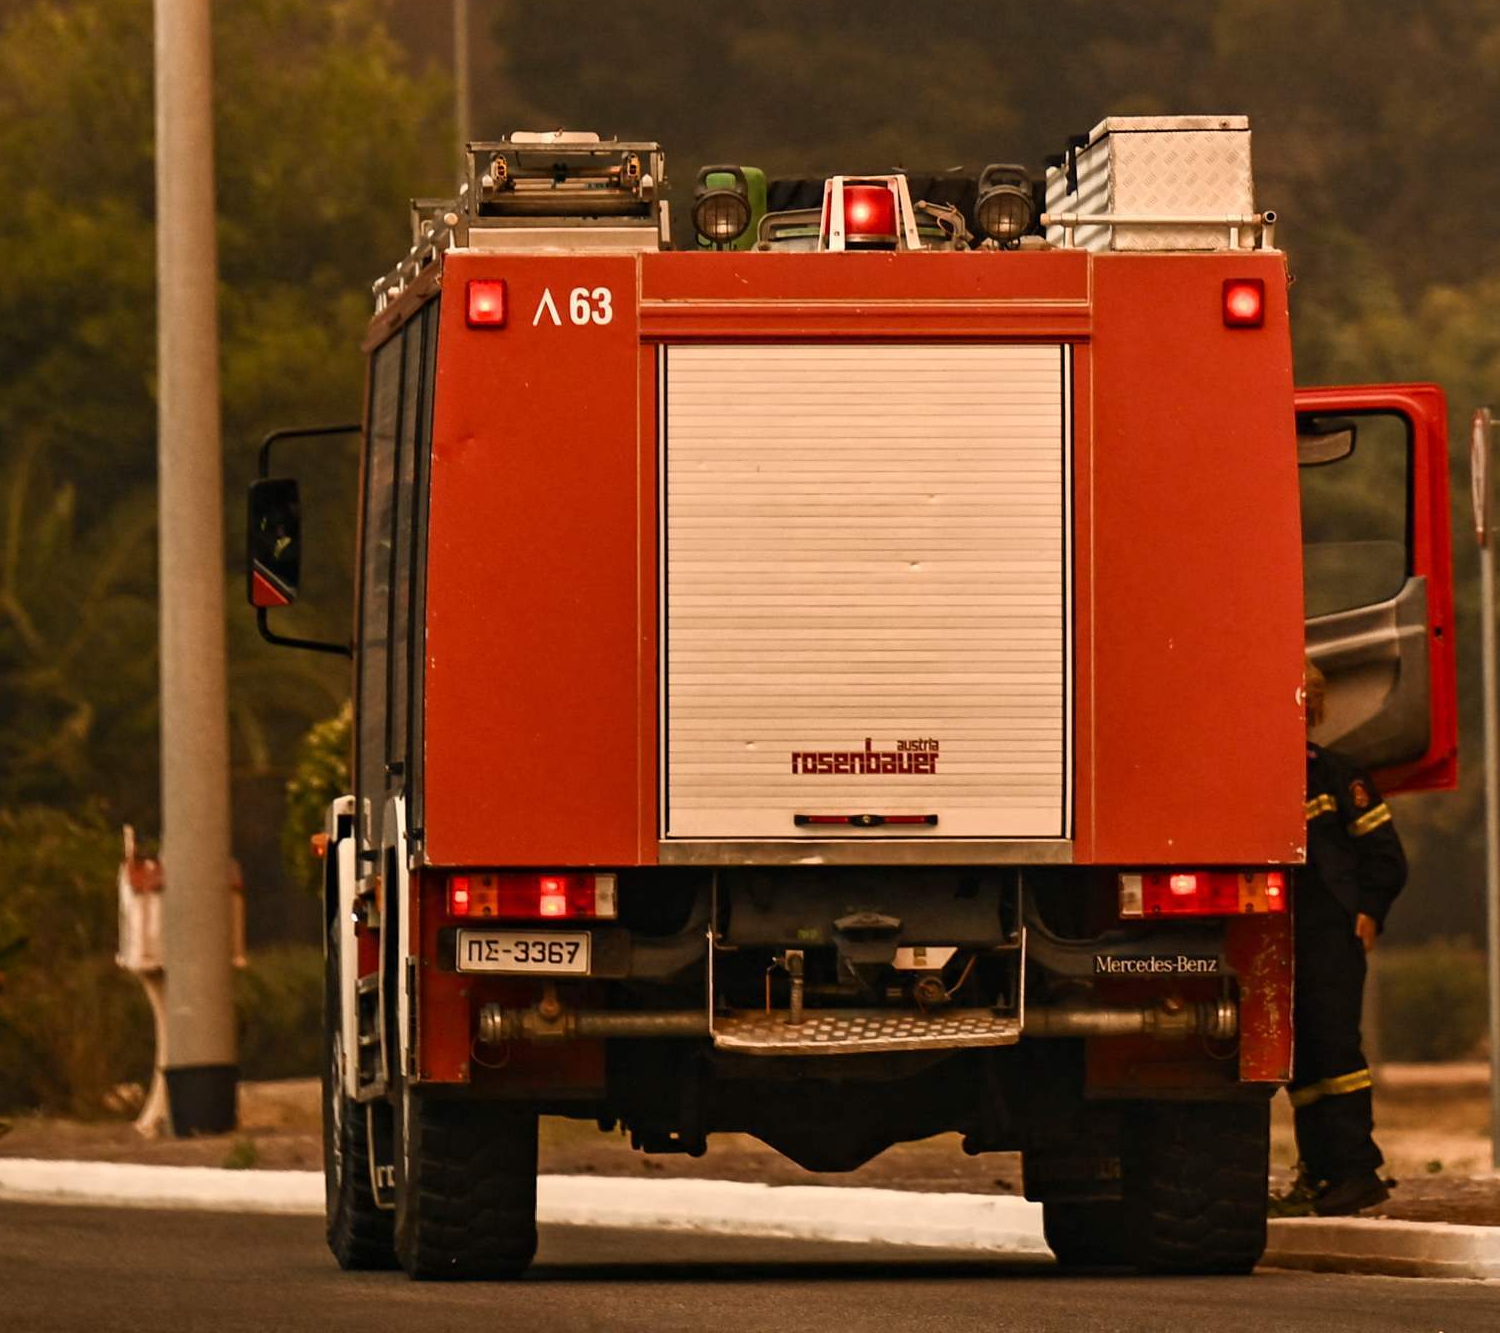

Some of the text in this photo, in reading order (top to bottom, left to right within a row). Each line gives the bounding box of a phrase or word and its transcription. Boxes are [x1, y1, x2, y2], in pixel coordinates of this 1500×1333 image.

[569, 286, 613, 326] 63
[792, 737, 939, 774] rosenbauer
[897, 738, 939, 751] austria
[468, 940, 581, 964] ΠΣ-3367
[1096, 955, 1218, 973] Mercedes-Benz
